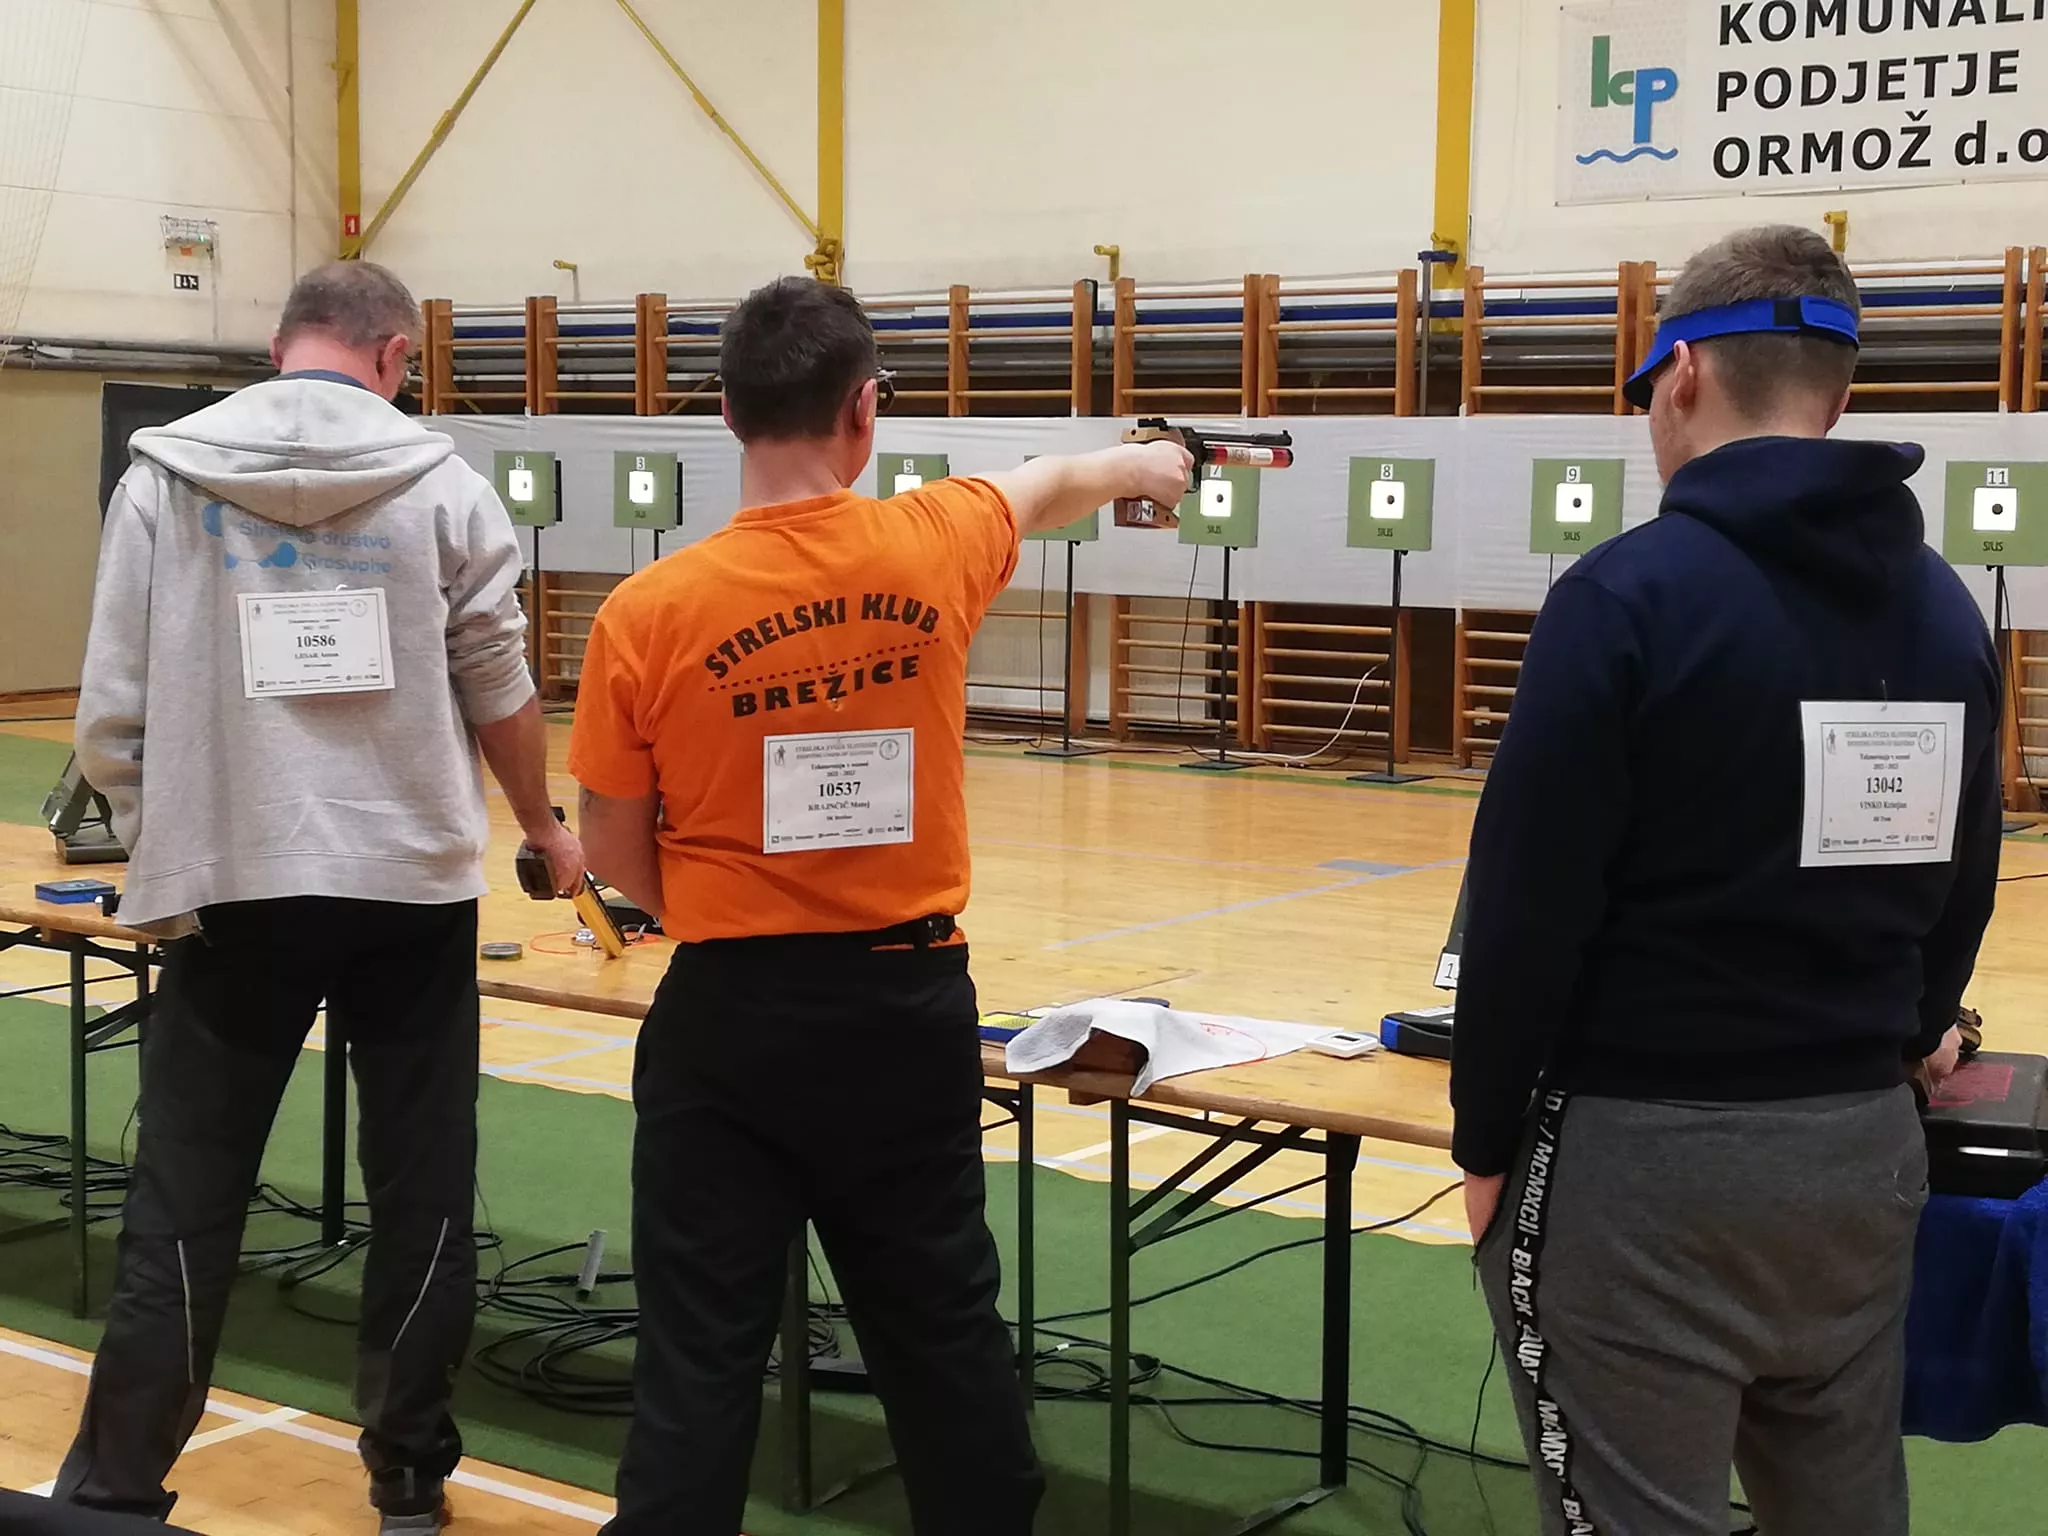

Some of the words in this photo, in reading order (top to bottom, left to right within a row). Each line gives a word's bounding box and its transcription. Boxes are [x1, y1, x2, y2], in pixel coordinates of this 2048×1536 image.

[1716, 49, 2020, 112] PODJETJE
[1712, 110, 1931, 179] ORMOŽ
[905, 461, 912, 473] 5
[1383, 465, 1391, 478] 8
[1568, 468, 1577, 481] 9
[1988, 470, 2007, 485] 11
[295, 634, 336, 648] 10586
[704, 596, 847, 680] STRELSKI
[860, 592, 940, 634] KLUB
[732, 655, 920, 718] BREŽICE
[818, 781, 862, 798] 10537
[1866, 776, 1903, 794] 13042
